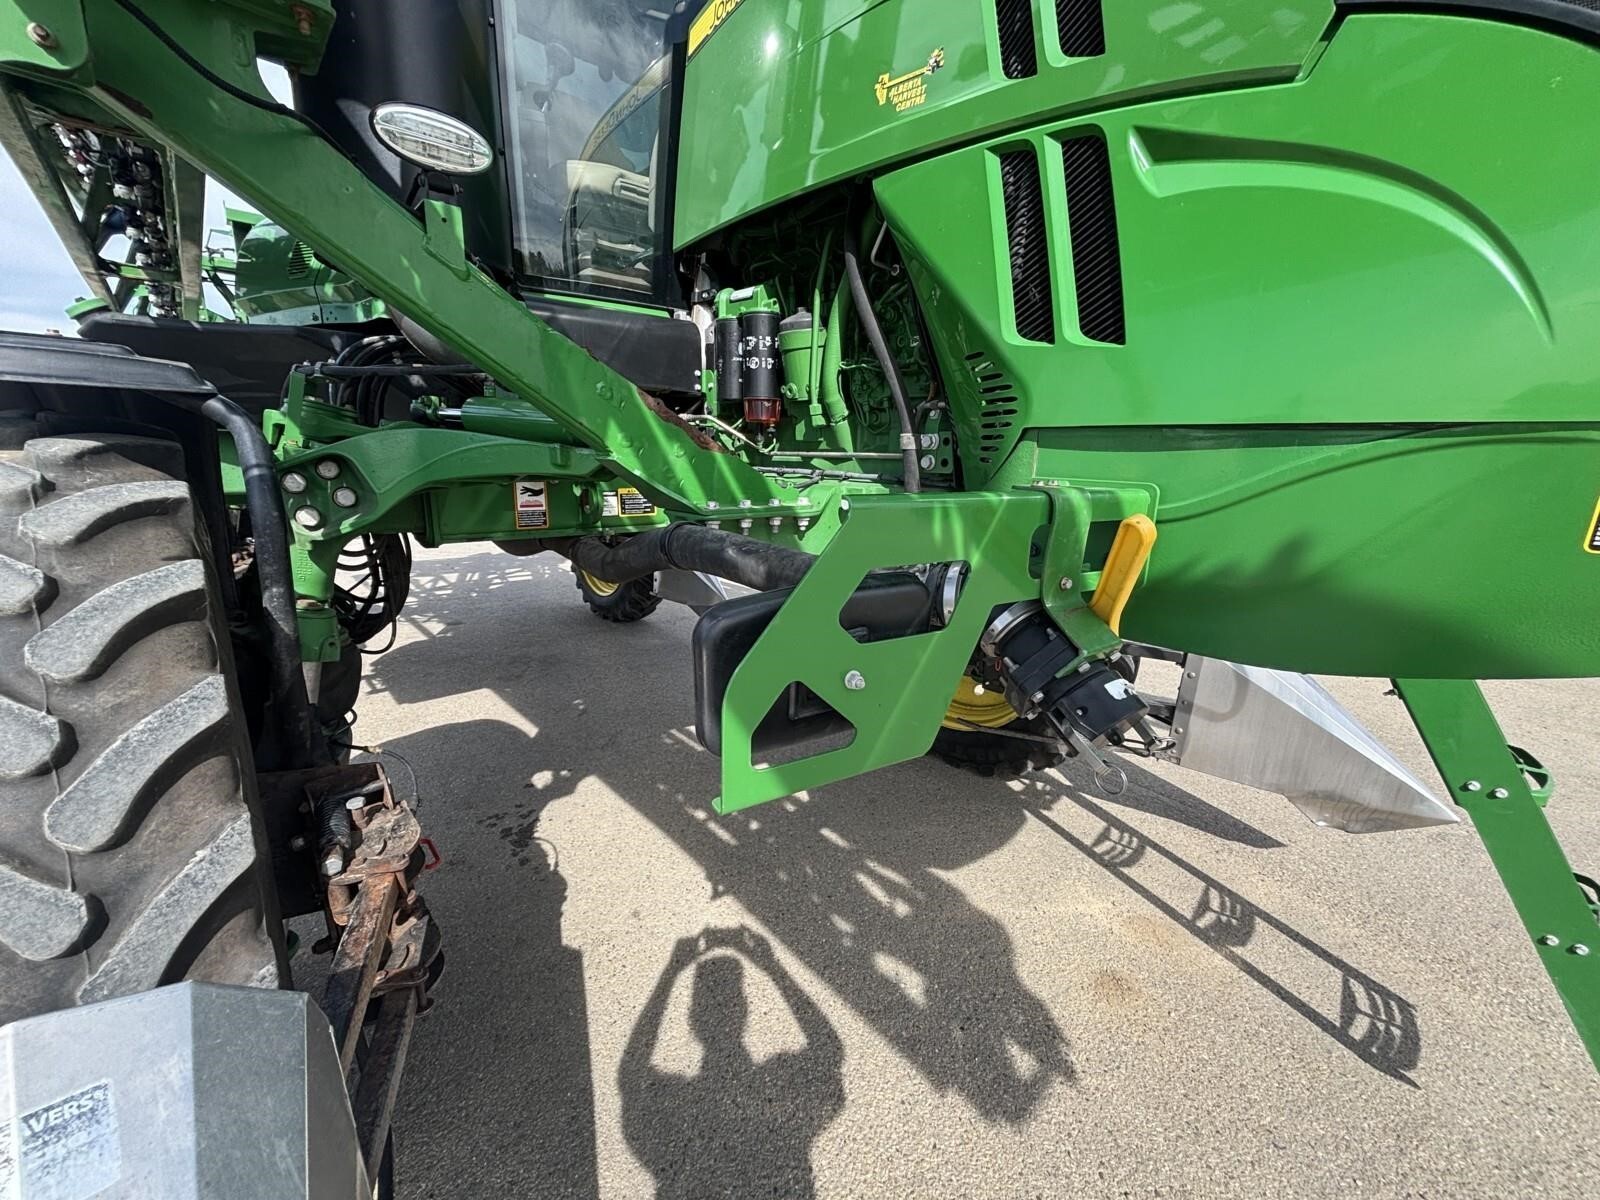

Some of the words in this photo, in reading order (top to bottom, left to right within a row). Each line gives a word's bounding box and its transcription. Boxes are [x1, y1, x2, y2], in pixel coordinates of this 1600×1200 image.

[709, 0, 738, 30] JOH
[888, 78, 922, 101] ALBERTA
[892, 84, 928, 105] HARVEST
[895, 94, 927, 112] CENTRE
